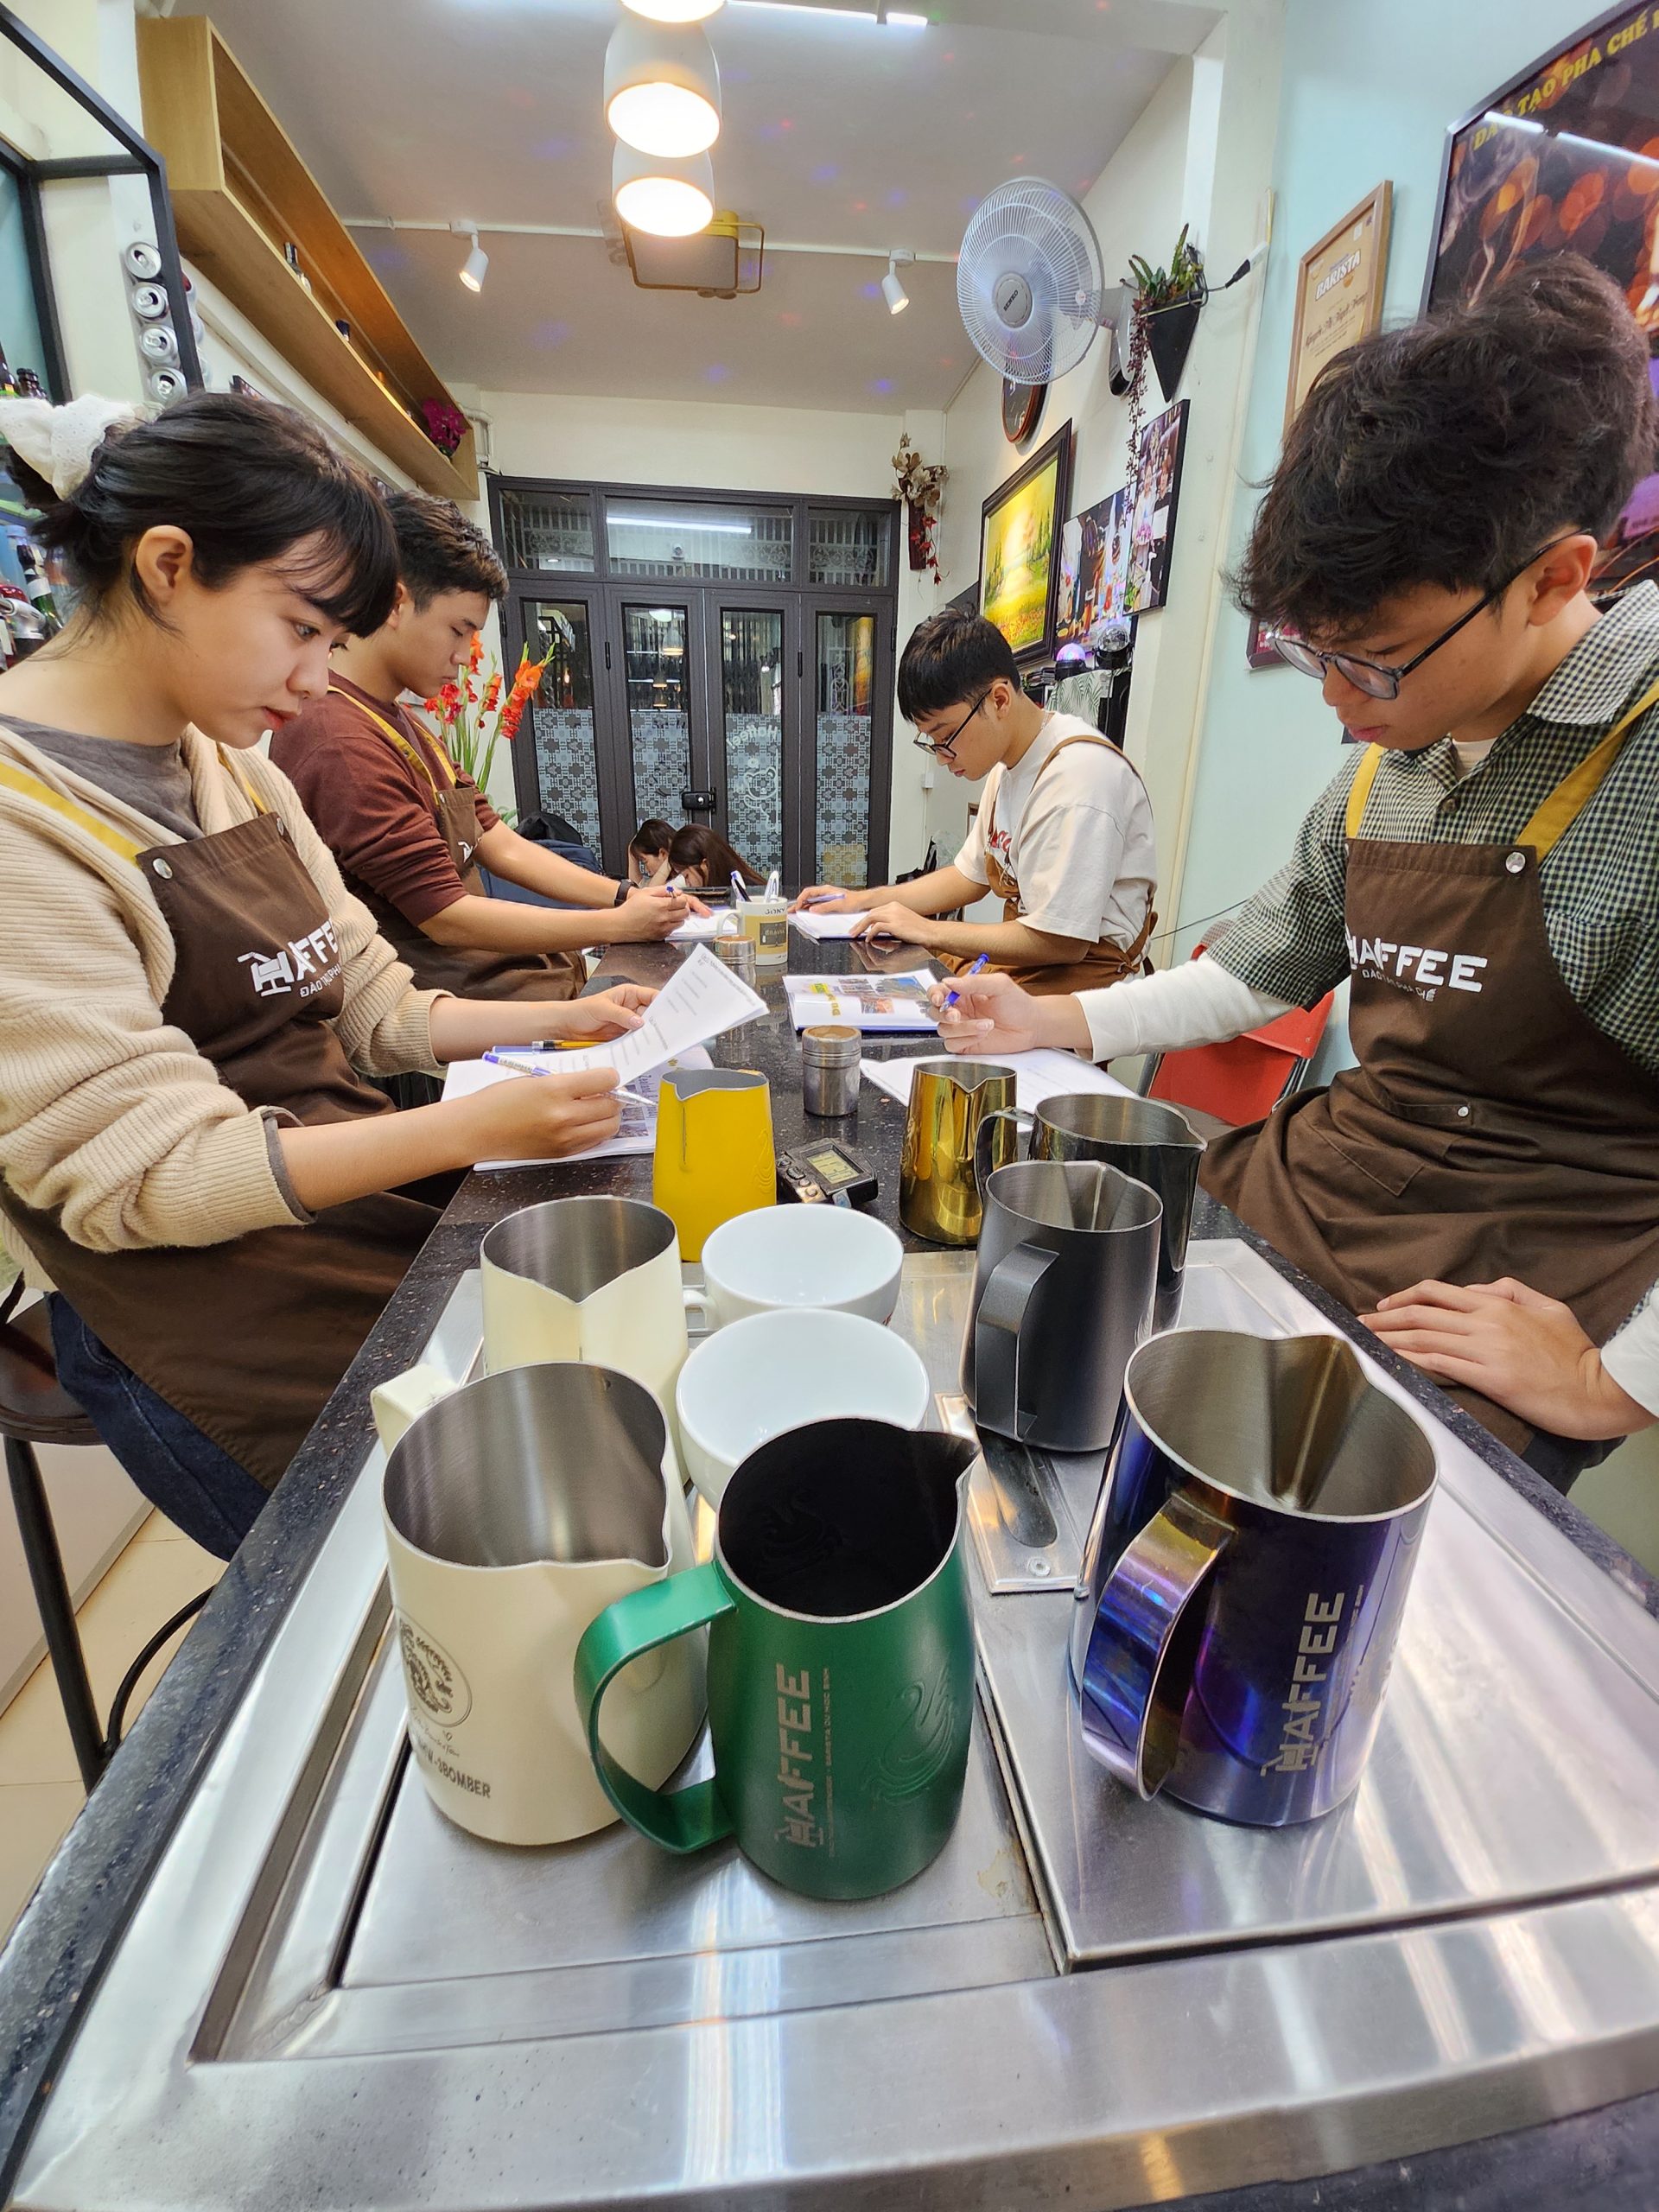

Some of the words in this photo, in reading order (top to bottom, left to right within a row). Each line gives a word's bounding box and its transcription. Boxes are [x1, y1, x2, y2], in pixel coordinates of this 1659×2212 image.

[1517, 79, 1556, 117] TẠO
[1561, 48, 1602, 87] PHA
[1607, 7, 1649, 55] CHẾ
[1315, 249, 1361, 301] BARISTA
[237, 918, 339, 997] HAFFE
[300, 980, 323, 998] ĐÀO
[1261, 1592, 1345, 1777] HAFFEE
[774, 1662, 823, 1848] HAFFEE
